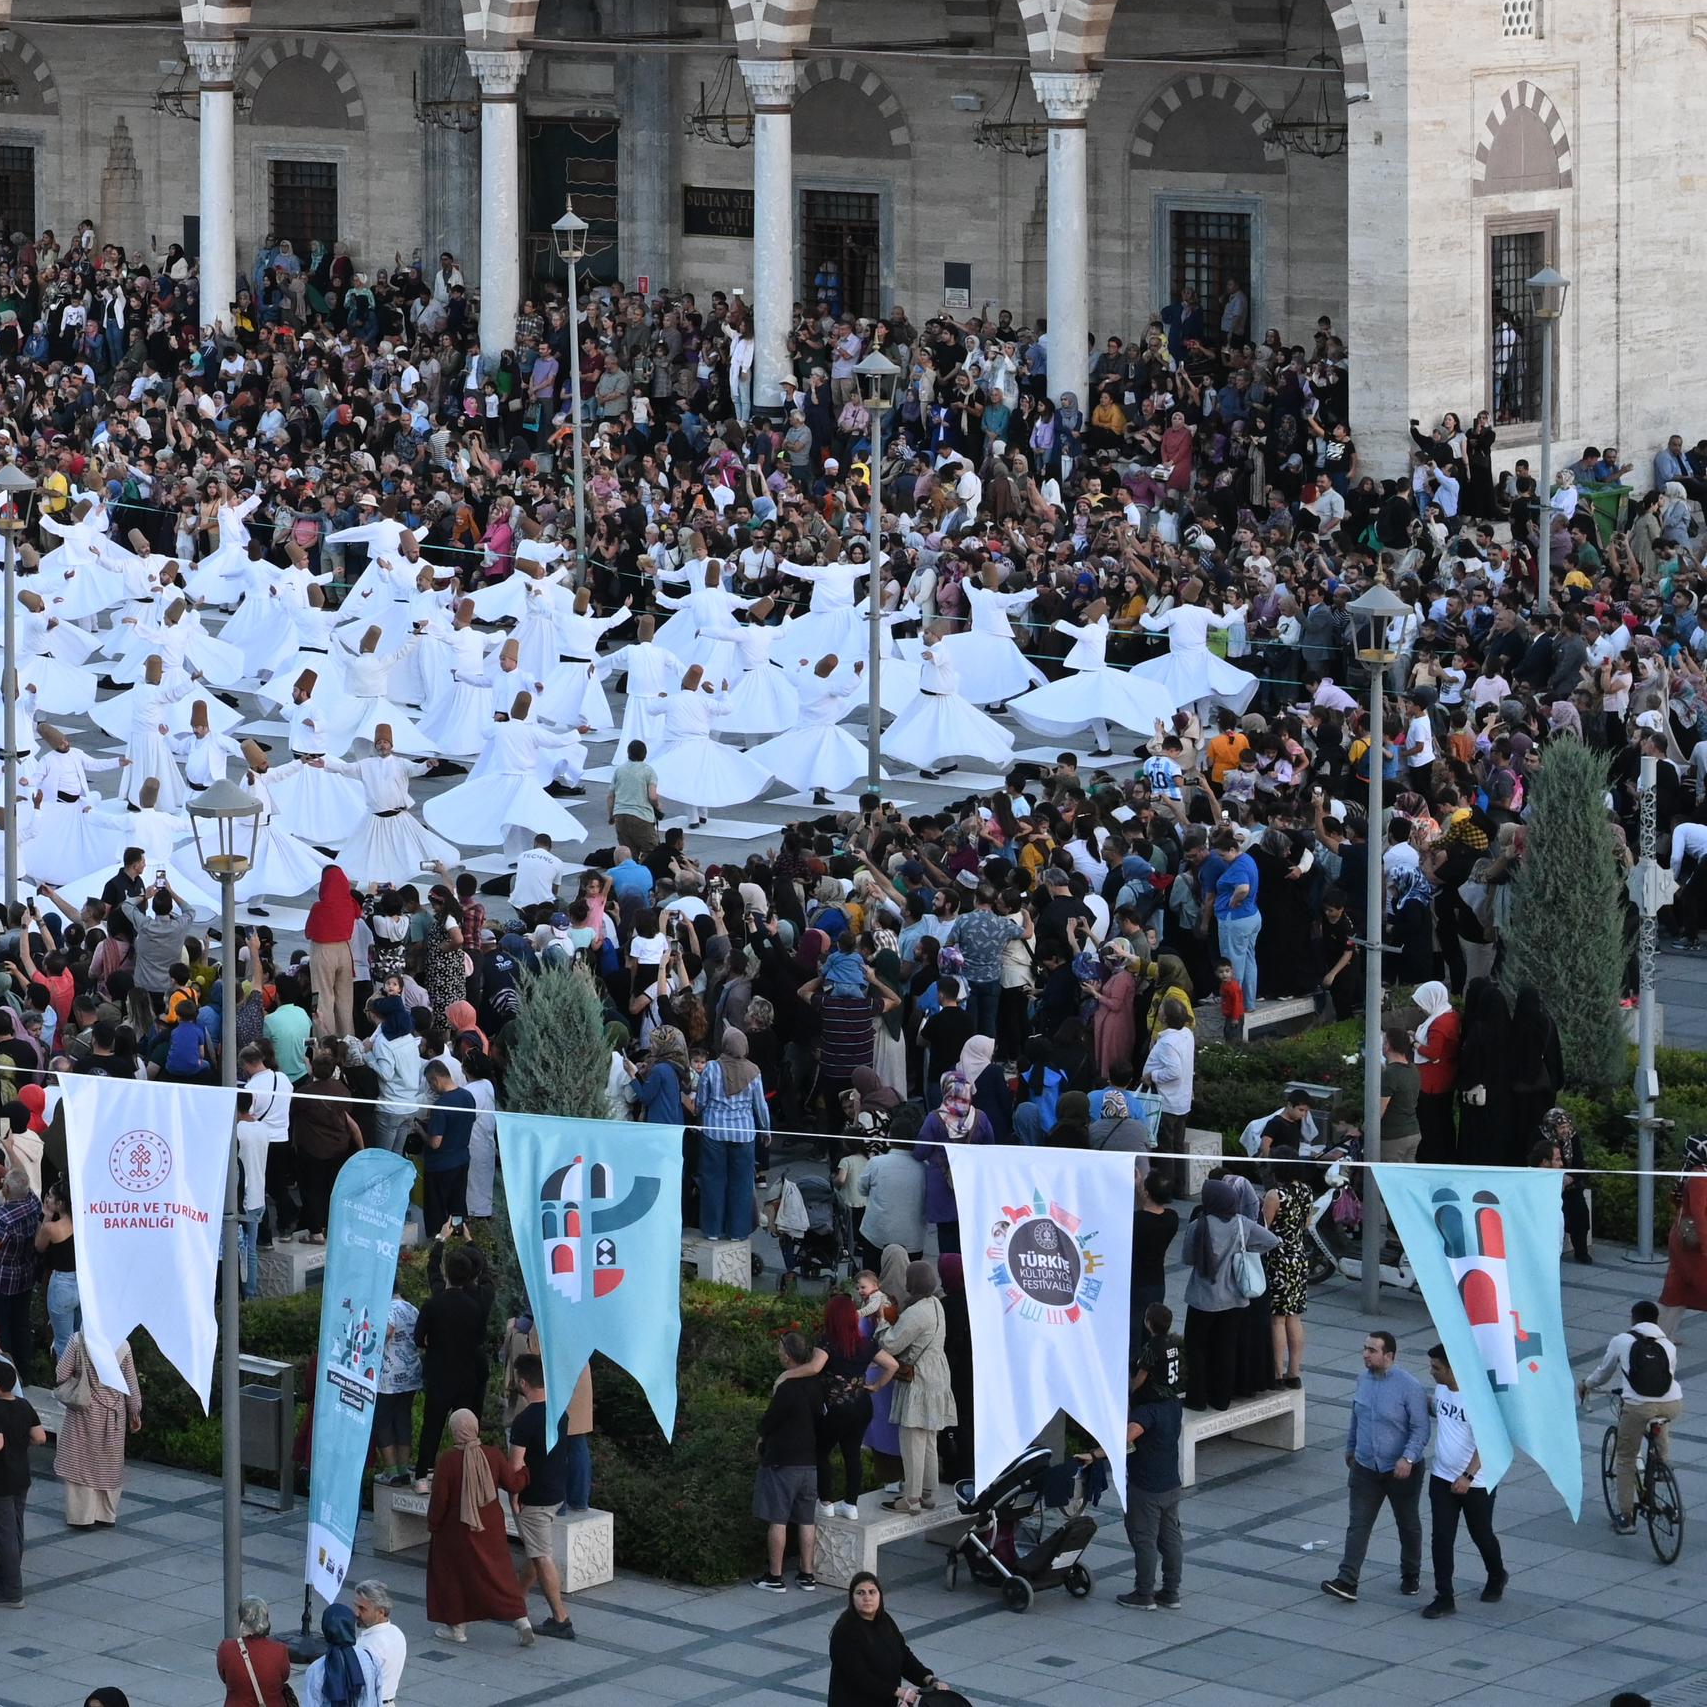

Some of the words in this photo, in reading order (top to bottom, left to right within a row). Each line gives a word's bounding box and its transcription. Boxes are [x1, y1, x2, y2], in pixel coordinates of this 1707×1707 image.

[1149, 770, 1168, 789] 10
[90, 1200, 140, 1214] KÜLTÜR
[143, 1202, 159, 1214] VE
[163, 1202, 209, 1224] TURİZM
[104, 1215, 175, 1229] BAKANLIĞI
[1020, 1267, 1055, 1279] KÜLTÜR
